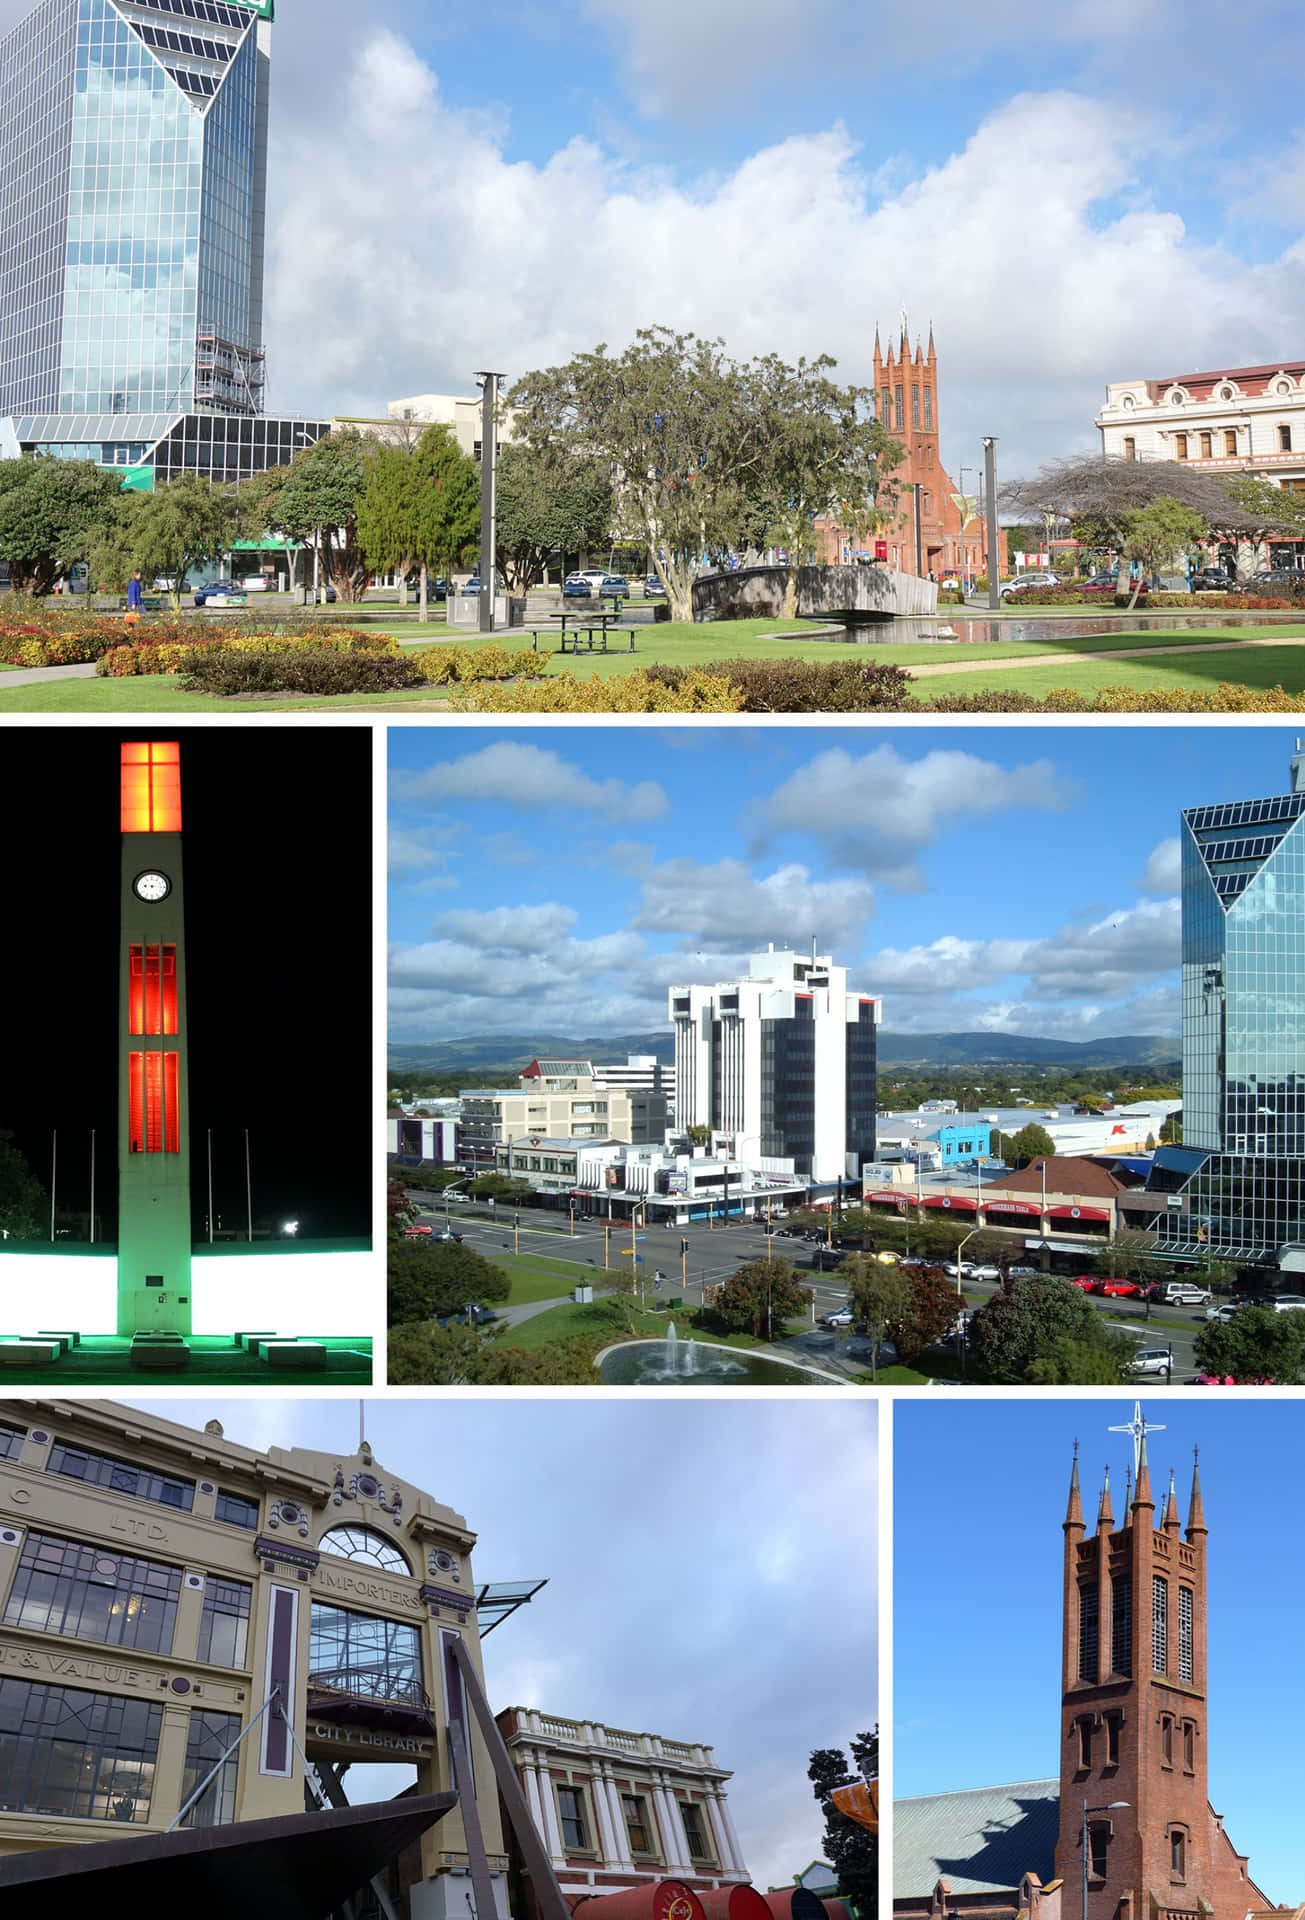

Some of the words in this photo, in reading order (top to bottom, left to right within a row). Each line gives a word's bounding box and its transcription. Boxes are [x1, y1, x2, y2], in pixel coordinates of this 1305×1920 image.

[319, 1569, 422, 1610] IMPORTERS
[18, 1651, 40, 1670] &
[47, 1655, 139, 1688] VALUE
[314, 1723, 353, 1743] CITY
[359, 1732, 425, 1754] LIBRARY
